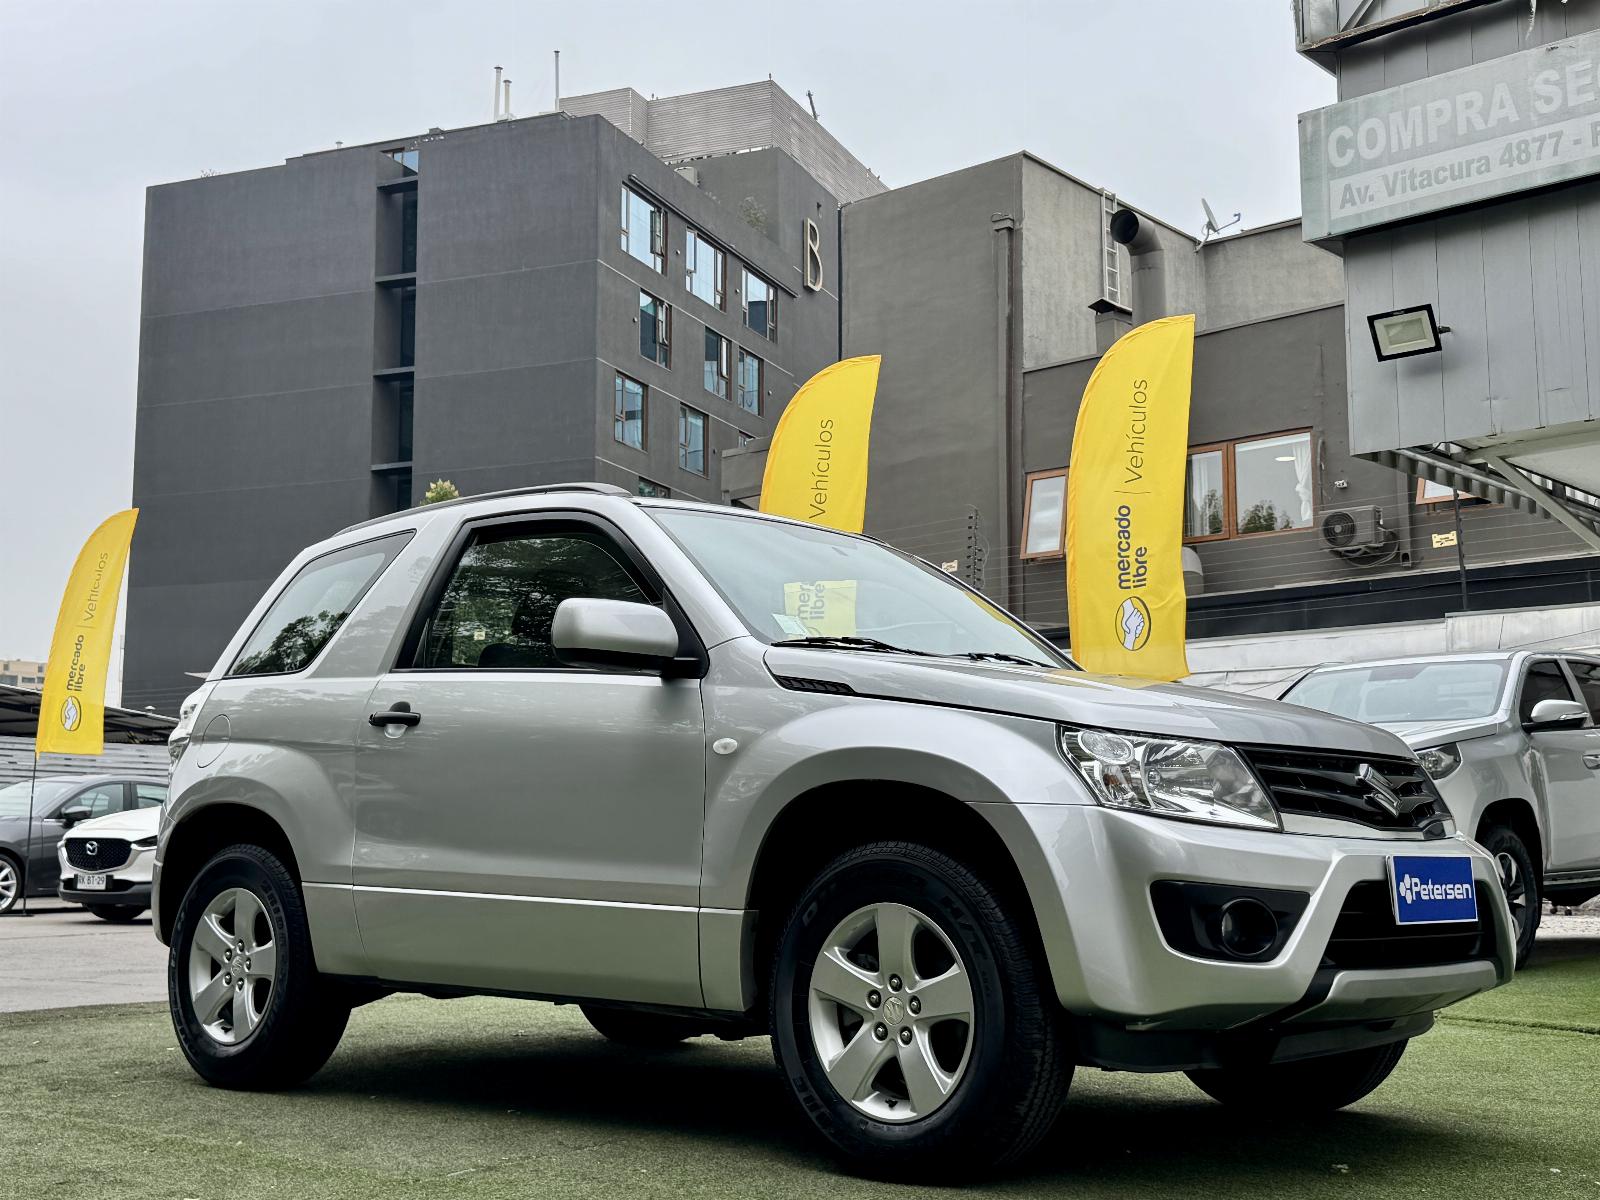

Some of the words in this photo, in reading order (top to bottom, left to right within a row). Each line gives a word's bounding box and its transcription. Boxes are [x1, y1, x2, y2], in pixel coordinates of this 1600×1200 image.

[1327, 82, 1520, 168] COMPRA
[1533, 61, 1600, 115] SE
[1339, 183, 1375, 210] Av.
[1381, 153, 1491, 198] Vitacura
[1500, 130, 1564, 168] 4877
[1124, 379, 1148, 484] Vehículos
[808, 419, 834, 519] Vehículos
[1114, 504, 1132, 591] mercado
[1132, 545, 1148, 588] libre
[809, 583, 825, 620] libre
[66, 634, 84, 691] mercado
[73, 663, 85, 692] libre
[1411, 877, 1472, 901] Petersen
